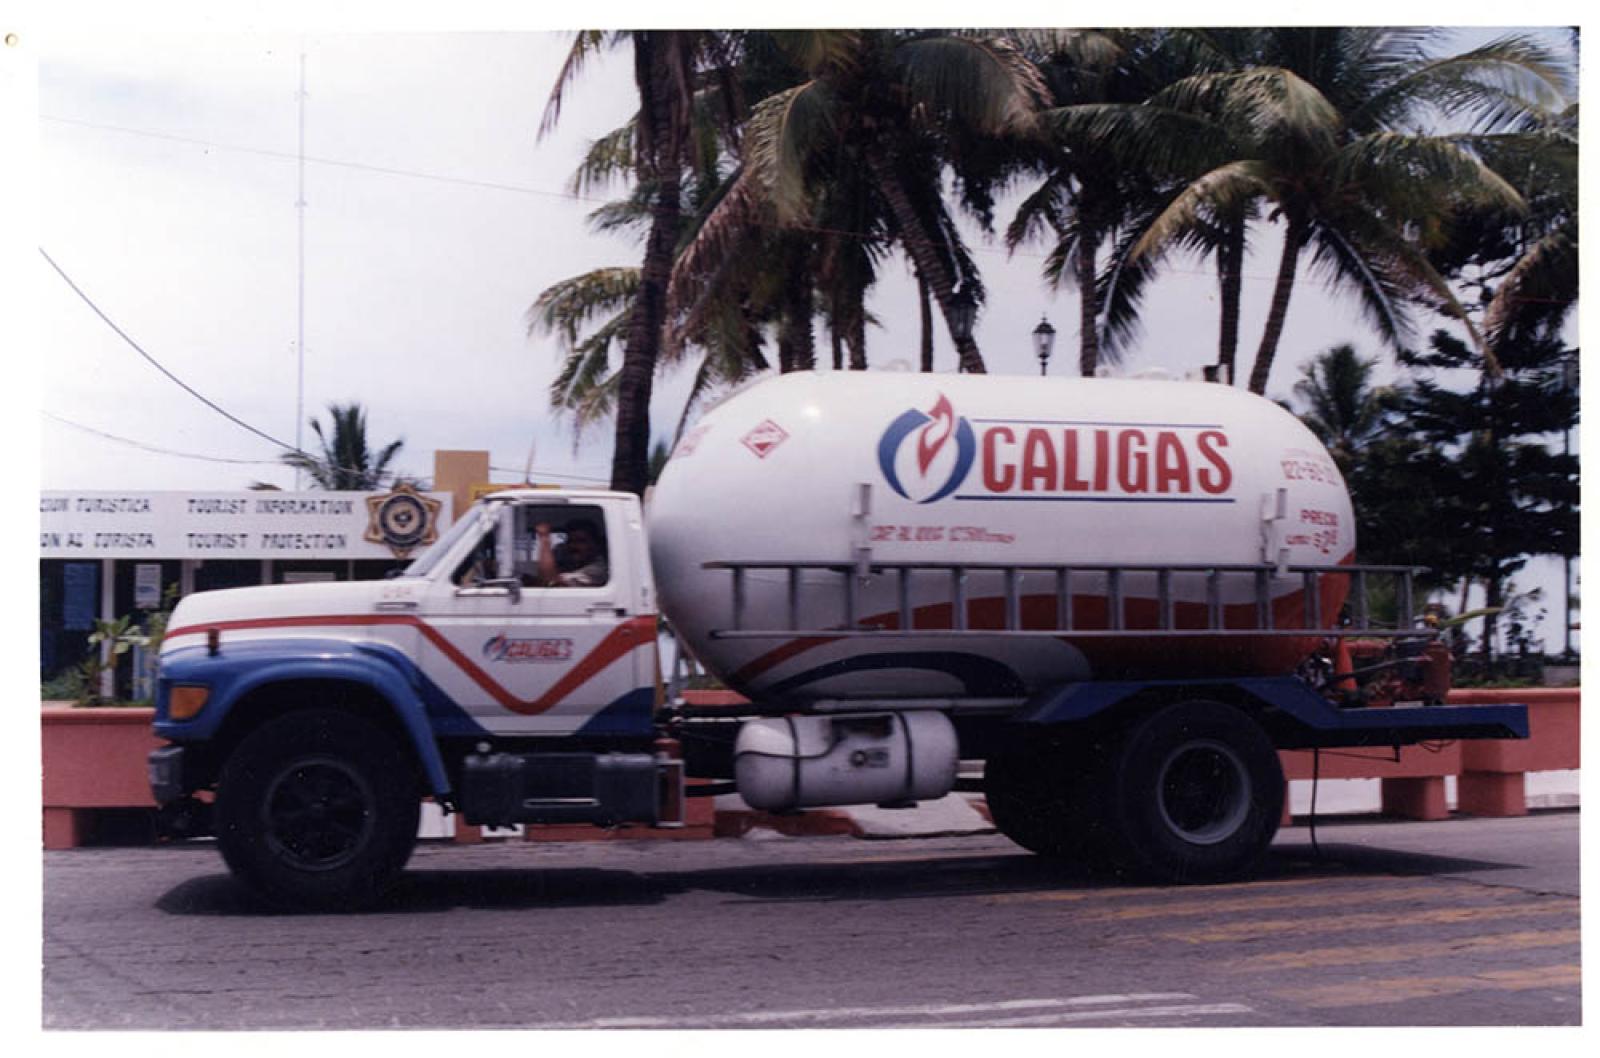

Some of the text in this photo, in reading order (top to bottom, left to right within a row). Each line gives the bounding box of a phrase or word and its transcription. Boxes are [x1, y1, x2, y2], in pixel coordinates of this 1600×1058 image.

[982, 426, 1233, 494] CALIGAS
[76, 498, 151, 512] TURISTICA
[187, 498, 354, 514] TOURIST INFORMATION
[94, 532, 155, 548] TURISTA
[186, 532, 348, 549] TOURIST PROTECTION
